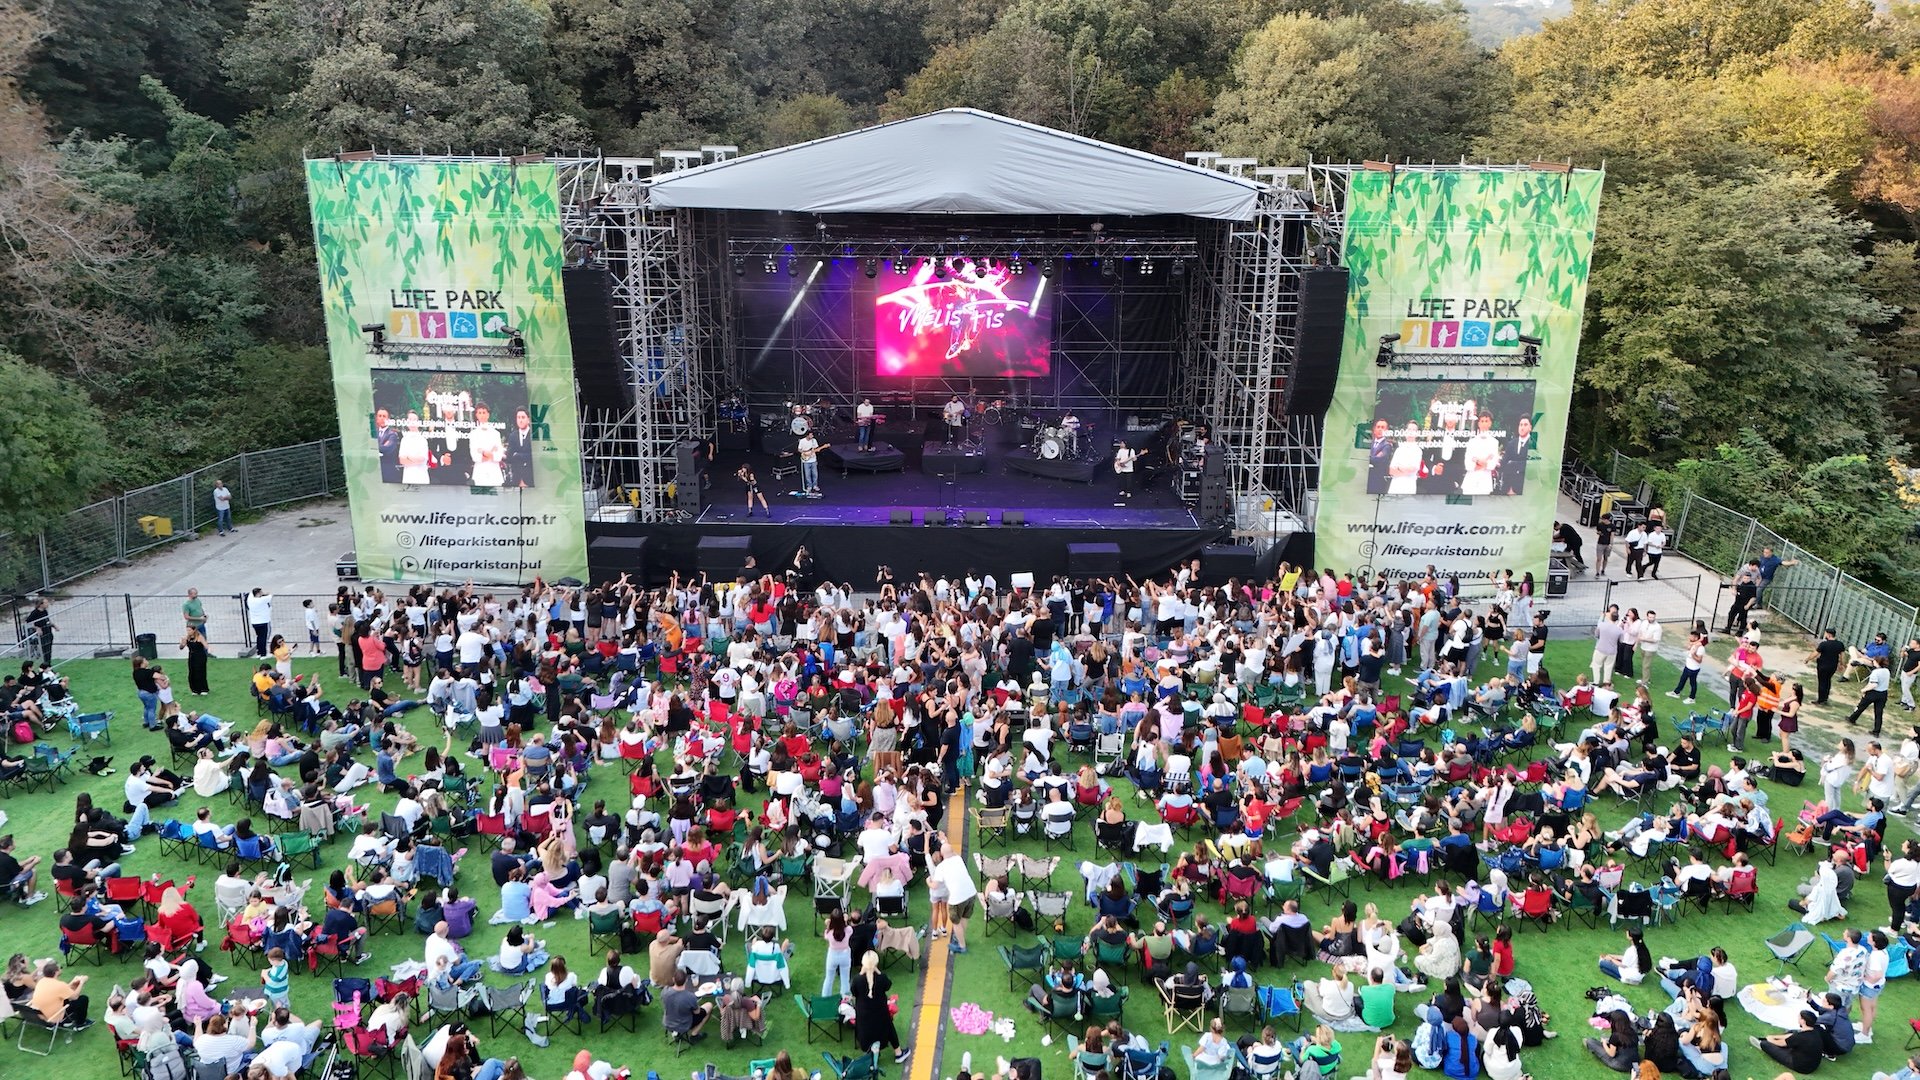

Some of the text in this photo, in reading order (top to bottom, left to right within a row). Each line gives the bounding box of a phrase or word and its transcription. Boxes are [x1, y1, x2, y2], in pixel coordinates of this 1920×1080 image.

[390, 289, 505, 310] LIFE PARK
[1407, 298, 1522, 319] LIFE PARK
[380, 512, 556, 528] www.lifepark.com.tr
[1347, 521, 1526, 537] www.lifepark.com.tr
[419, 534, 539, 548] /lifeparkistanbul
[1381, 543, 1504, 558] /lifeparkistanbul
[422, 558, 542, 571] /lifeparkistanbul
[1382, 567, 1500, 580] /lifepakistanbul
[722, 673, 730, 682] 9
